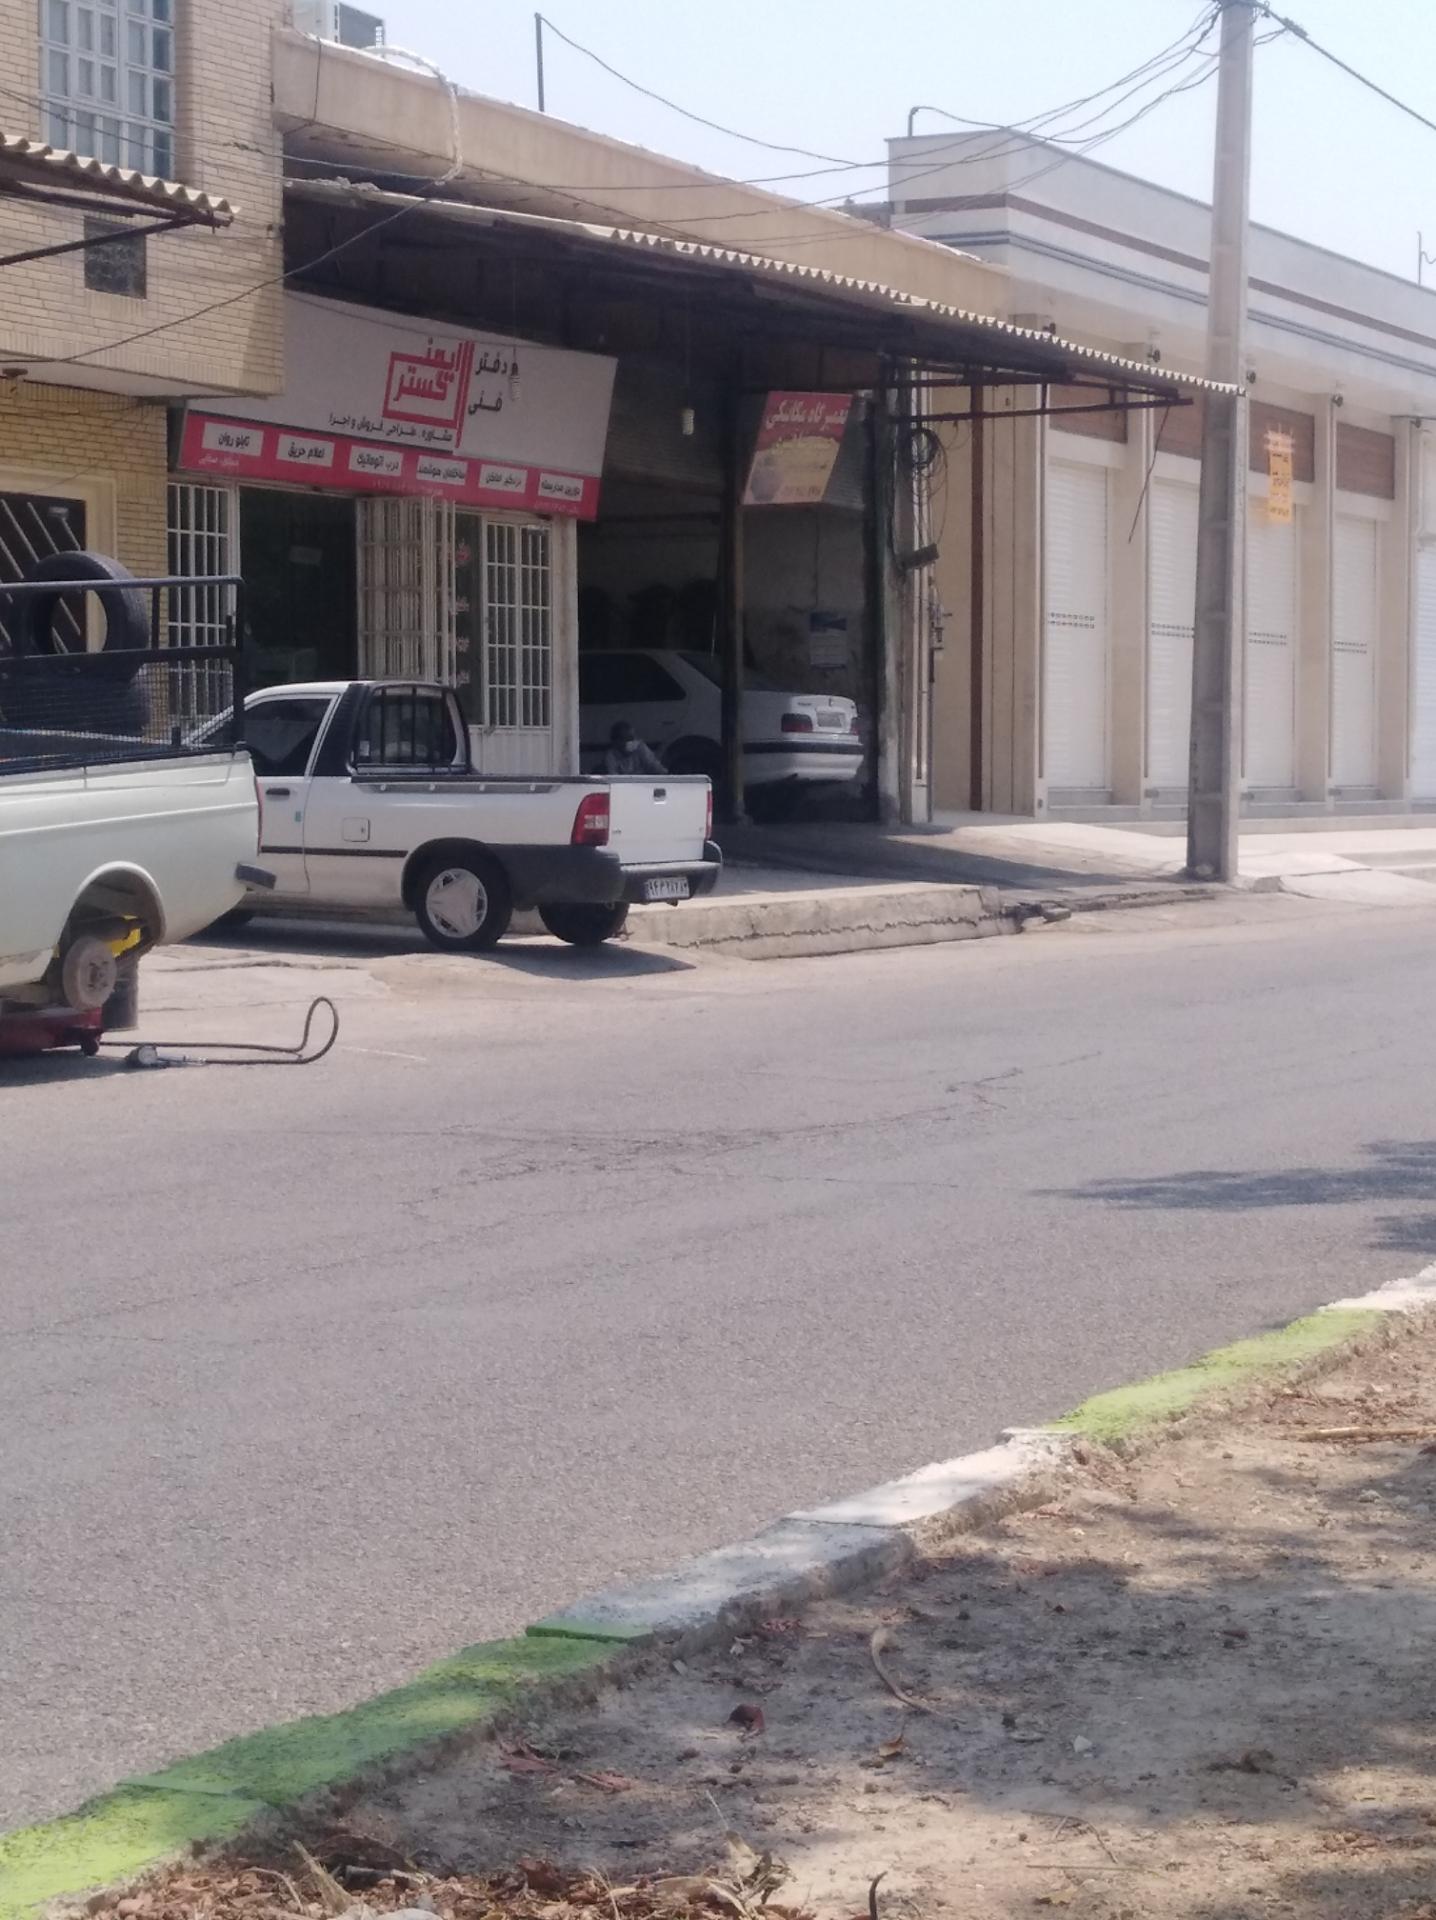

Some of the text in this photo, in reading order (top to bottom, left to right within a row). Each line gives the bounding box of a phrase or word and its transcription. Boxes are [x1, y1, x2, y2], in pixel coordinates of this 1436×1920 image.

[475, 351, 508, 375] دفتر
[392, 365, 455, 401] گستر
[468, 390, 503, 415] فنی
[328, 412, 351, 426] اجرا
[218, 432, 250, 449] تابلو روان
[287, 441, 325, 459] اعلام حریق
[385, 461, 399, 471] درب
